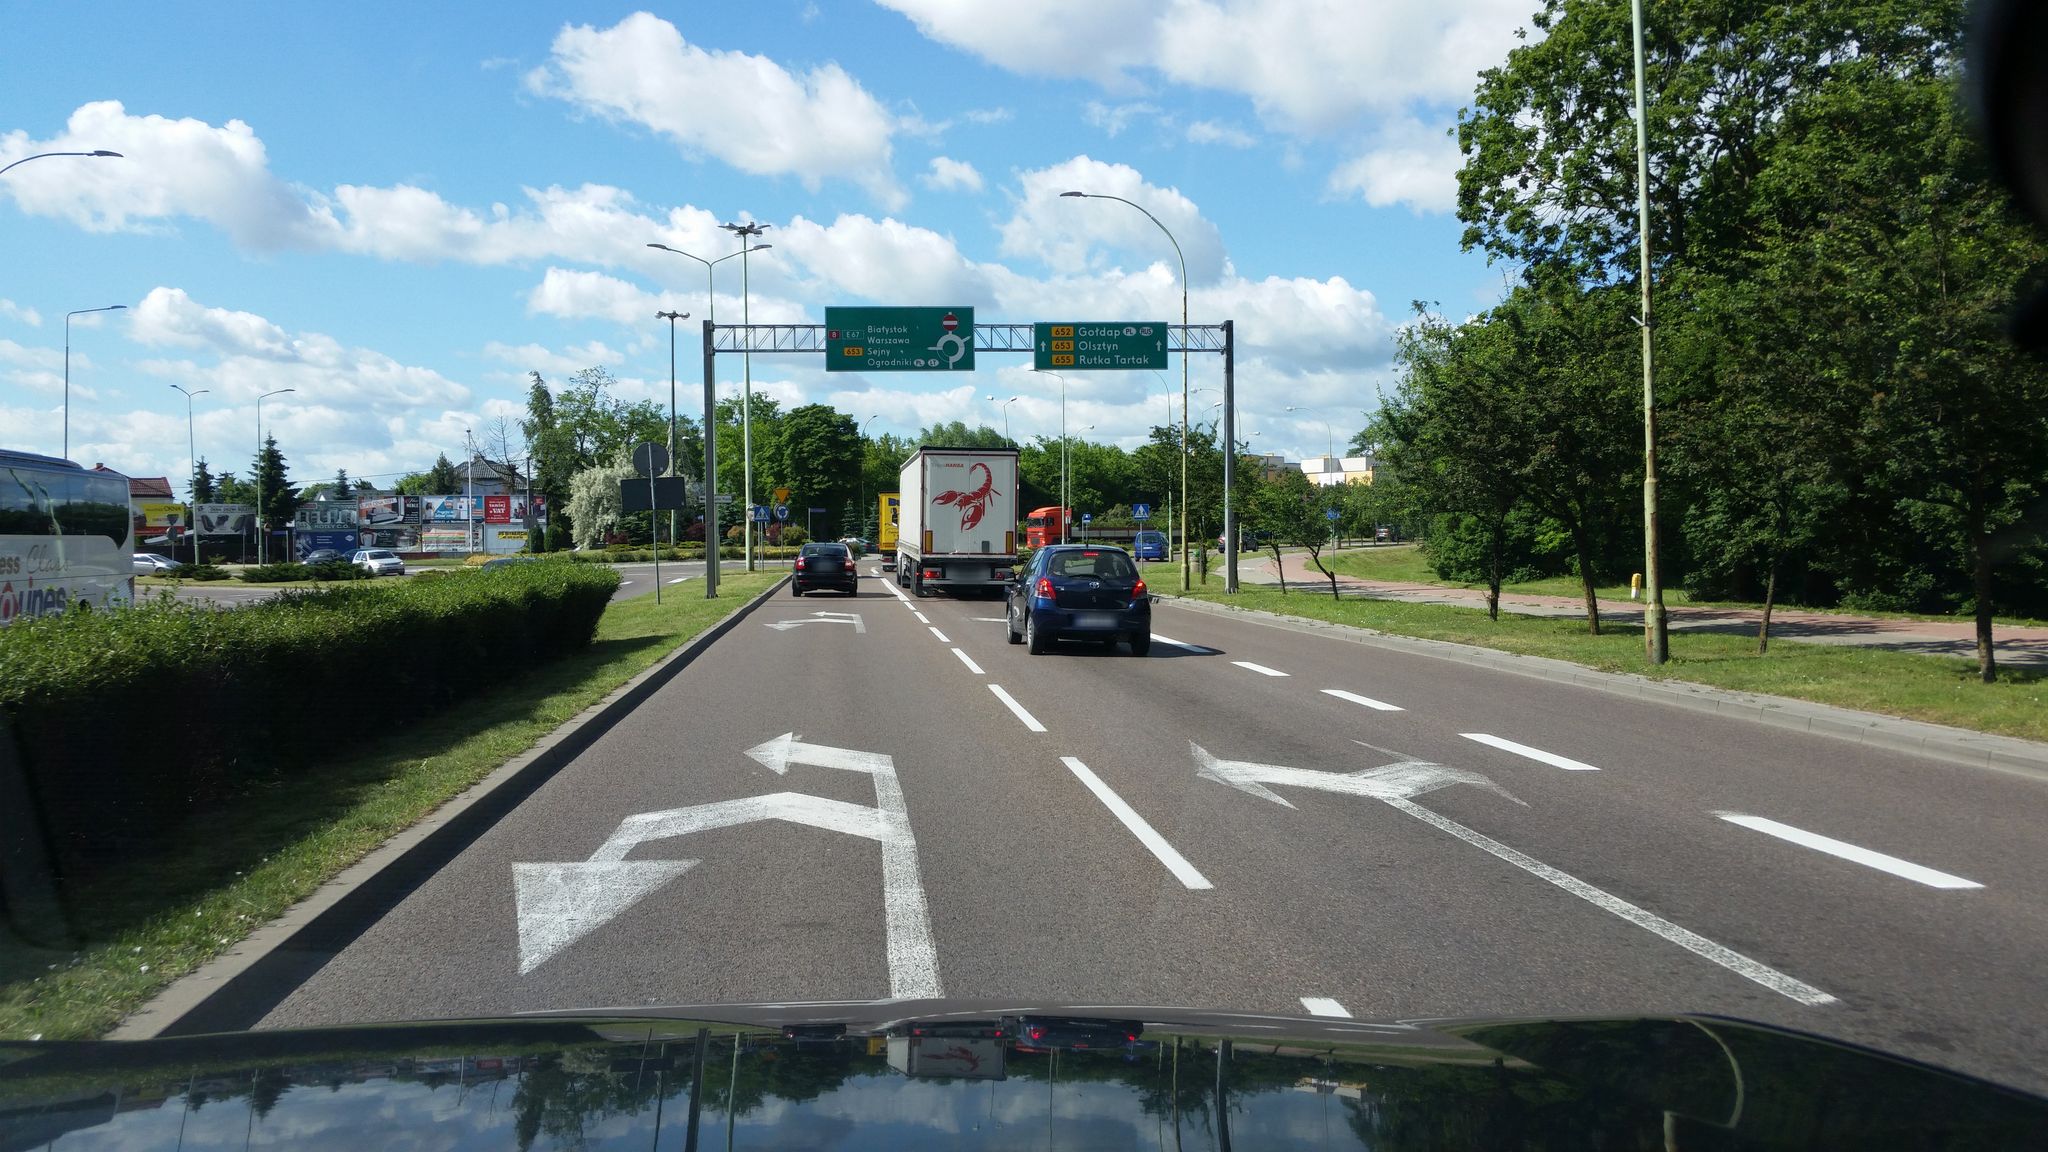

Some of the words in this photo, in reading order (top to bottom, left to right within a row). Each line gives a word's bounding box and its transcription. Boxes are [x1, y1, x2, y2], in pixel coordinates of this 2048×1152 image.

[867, 325, 908, 334] Białystok
[1055, 328, 1071, 336] 652
[1078, 327, 1121, 339] Gołdap
[1055, 342, 1071, 350] 653
[1078, 341, 1119, 352] Olsztyn
[867, 347, 891, 357] Sejny
[867, 358, 912, 368] Ogrodniki
[1055, 356, 1071, 364] 655
[1079, 355, 1111, 365] Rutka
[1115, 355, 1149, 365] Tartak
